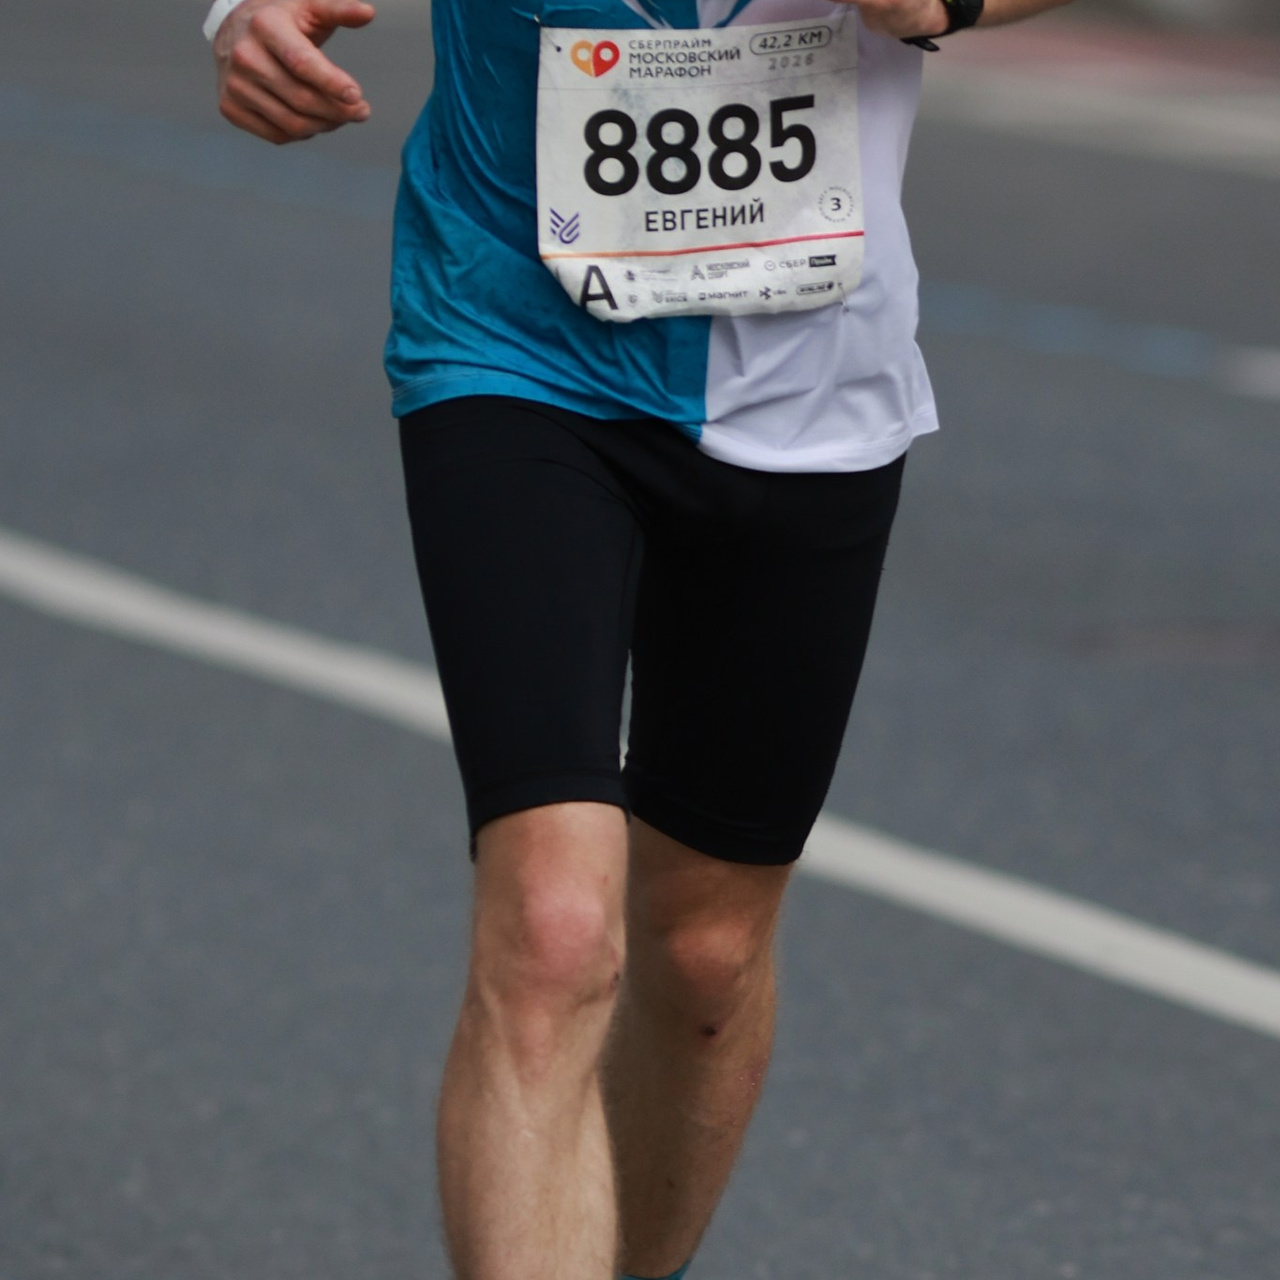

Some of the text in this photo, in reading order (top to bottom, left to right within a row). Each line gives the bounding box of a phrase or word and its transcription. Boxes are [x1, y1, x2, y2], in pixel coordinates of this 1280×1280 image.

[629, 38, 712, 50] СБЕРПРАЙМ
[629, 47, 741, 64] МОСКОВСКИЙ
[629, 65, 712, 79] МАРАФОН
[584, 94, 816, 196] 8885
[831, 197, 842, 211] 3
[645, 198, 765, 232] ЕВГЕНИЙ
